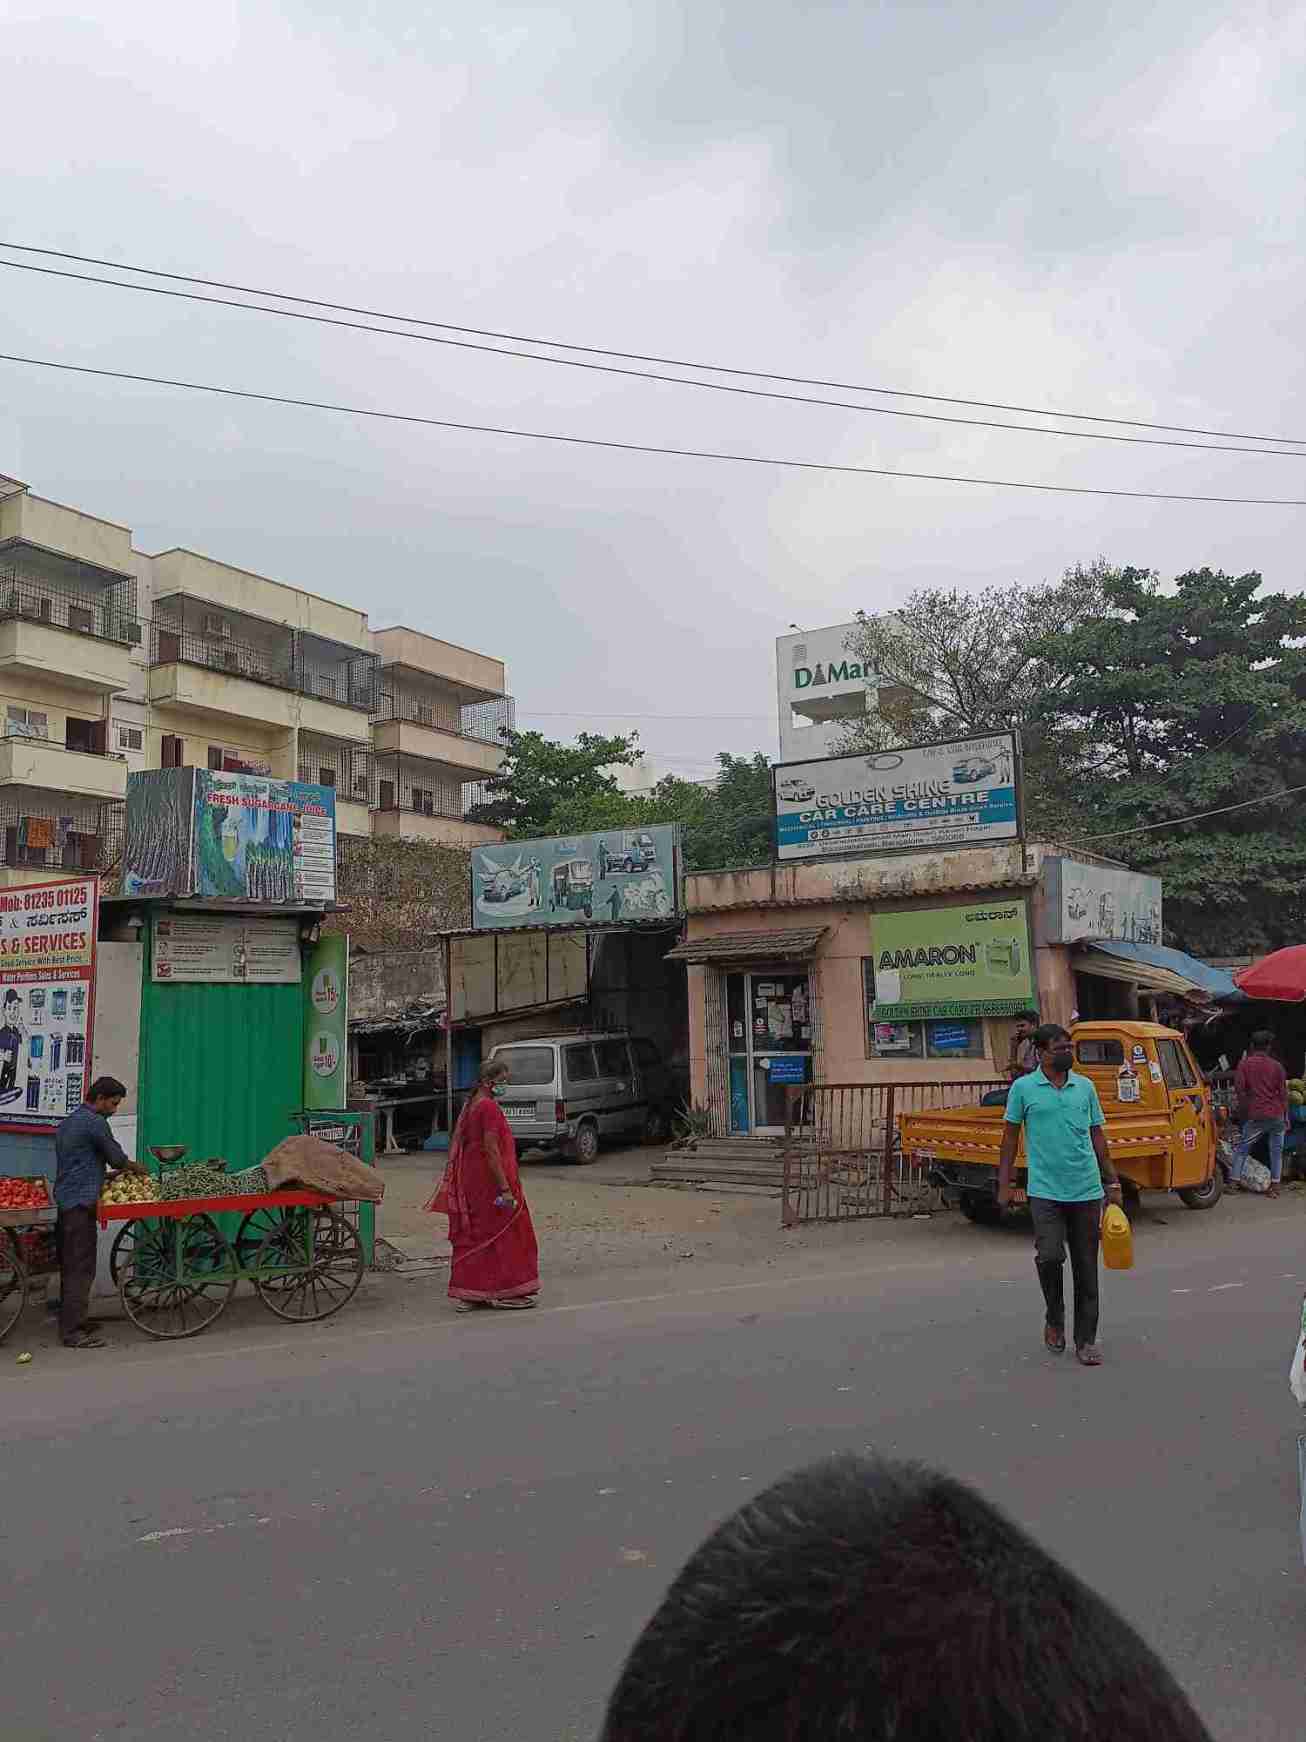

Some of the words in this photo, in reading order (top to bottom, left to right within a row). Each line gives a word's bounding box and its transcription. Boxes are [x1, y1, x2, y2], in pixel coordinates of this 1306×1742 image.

[207, 792, 239, 806] FRESH
[816, 784, 889, 808] GOLDEN
[892, 778, 952, 801] SHINE
[800, 807, 842, 823] CAR
[844, 801, 897, 818] CARE
[904, 791, 989, 811] CENTRE
[24, 890, 55, 910] 81235
[57, 887, 87, 906] 01125
[24, 931, 86, 954] SERVICES
[879, 944, 977, 970] AMARON
